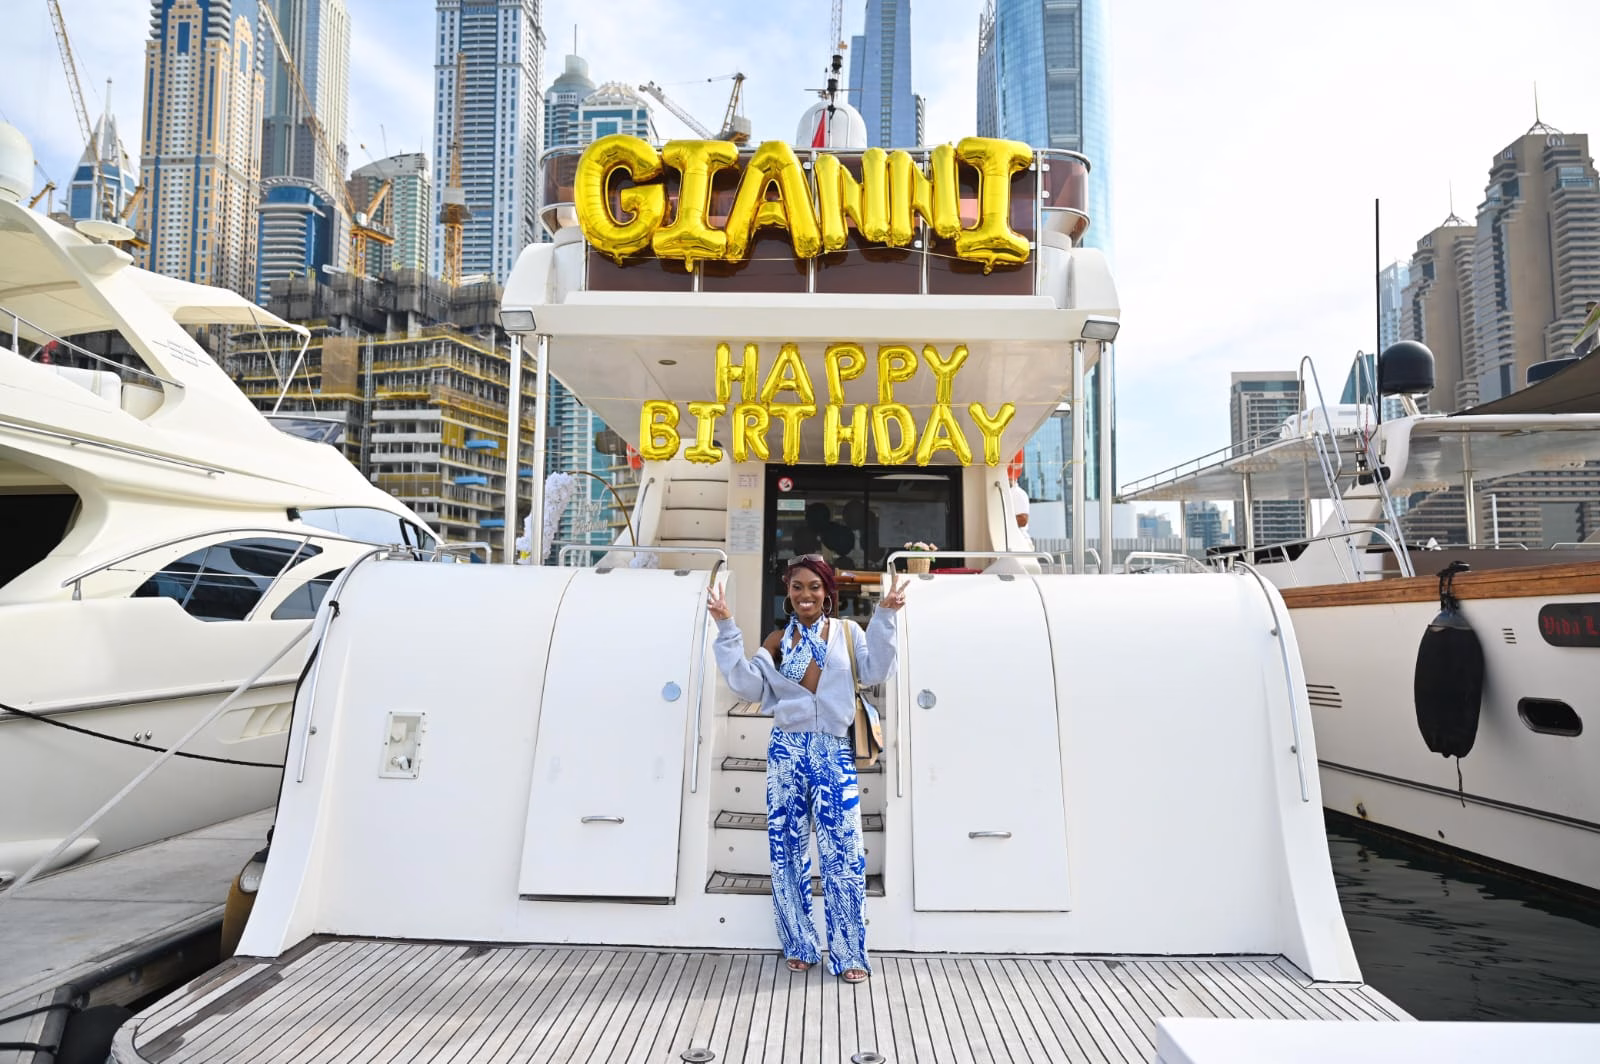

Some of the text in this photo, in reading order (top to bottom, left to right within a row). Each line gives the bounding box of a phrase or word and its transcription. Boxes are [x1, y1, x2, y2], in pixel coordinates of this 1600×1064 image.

[574, 134, 1034, 275] GIANNI
[715, 342, 969, 404] HAPPY
[639, 400, 1016, 467] BIRTHDAY
